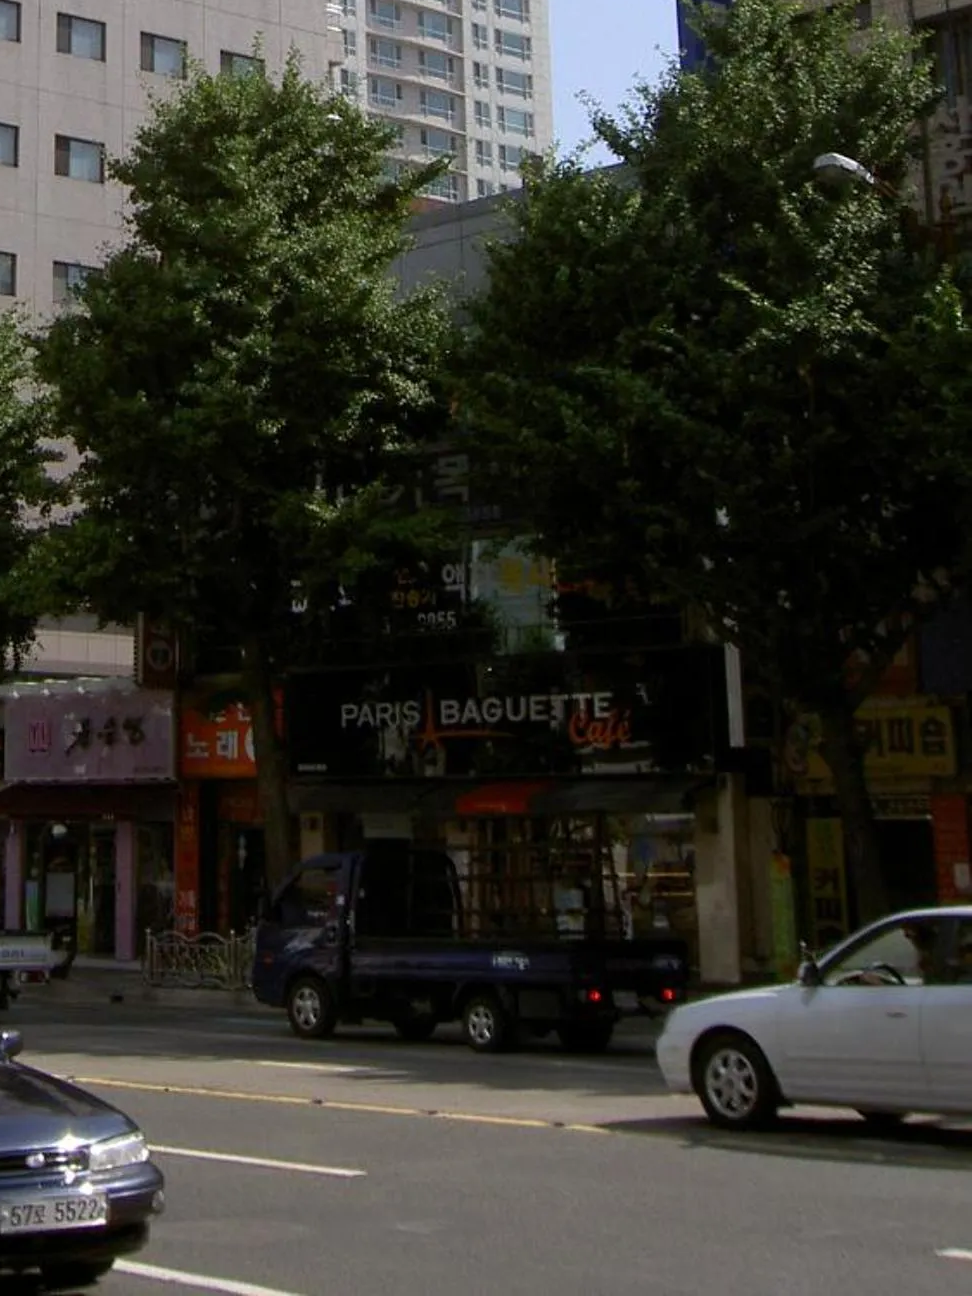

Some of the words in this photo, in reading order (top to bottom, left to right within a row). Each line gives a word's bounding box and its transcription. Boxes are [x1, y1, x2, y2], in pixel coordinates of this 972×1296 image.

[340, 701, 421, 729] PARIS
[439, 691, 614, 725] BAGUETTE
[55, 1198, 101, 1222] 5522
